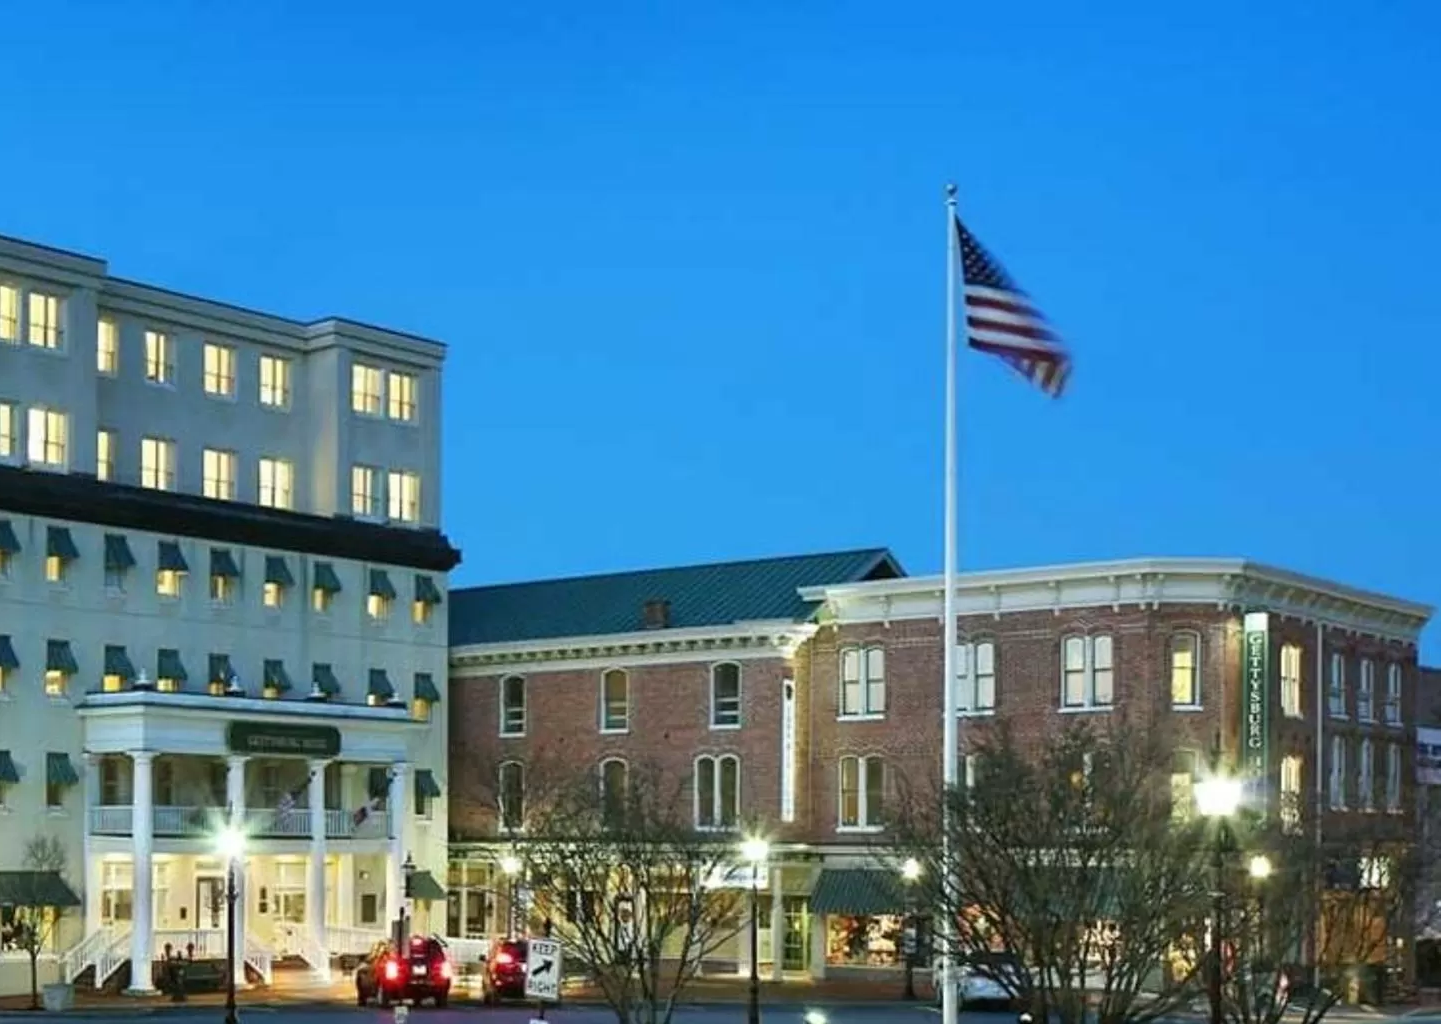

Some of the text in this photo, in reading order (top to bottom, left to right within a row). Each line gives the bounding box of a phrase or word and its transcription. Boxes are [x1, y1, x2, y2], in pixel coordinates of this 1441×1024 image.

[1248, 632, 1264, 749] GETTYSBURG
[532, 942, 558, 956] KEEP
[528, 980, 557, 994] RIGHT
